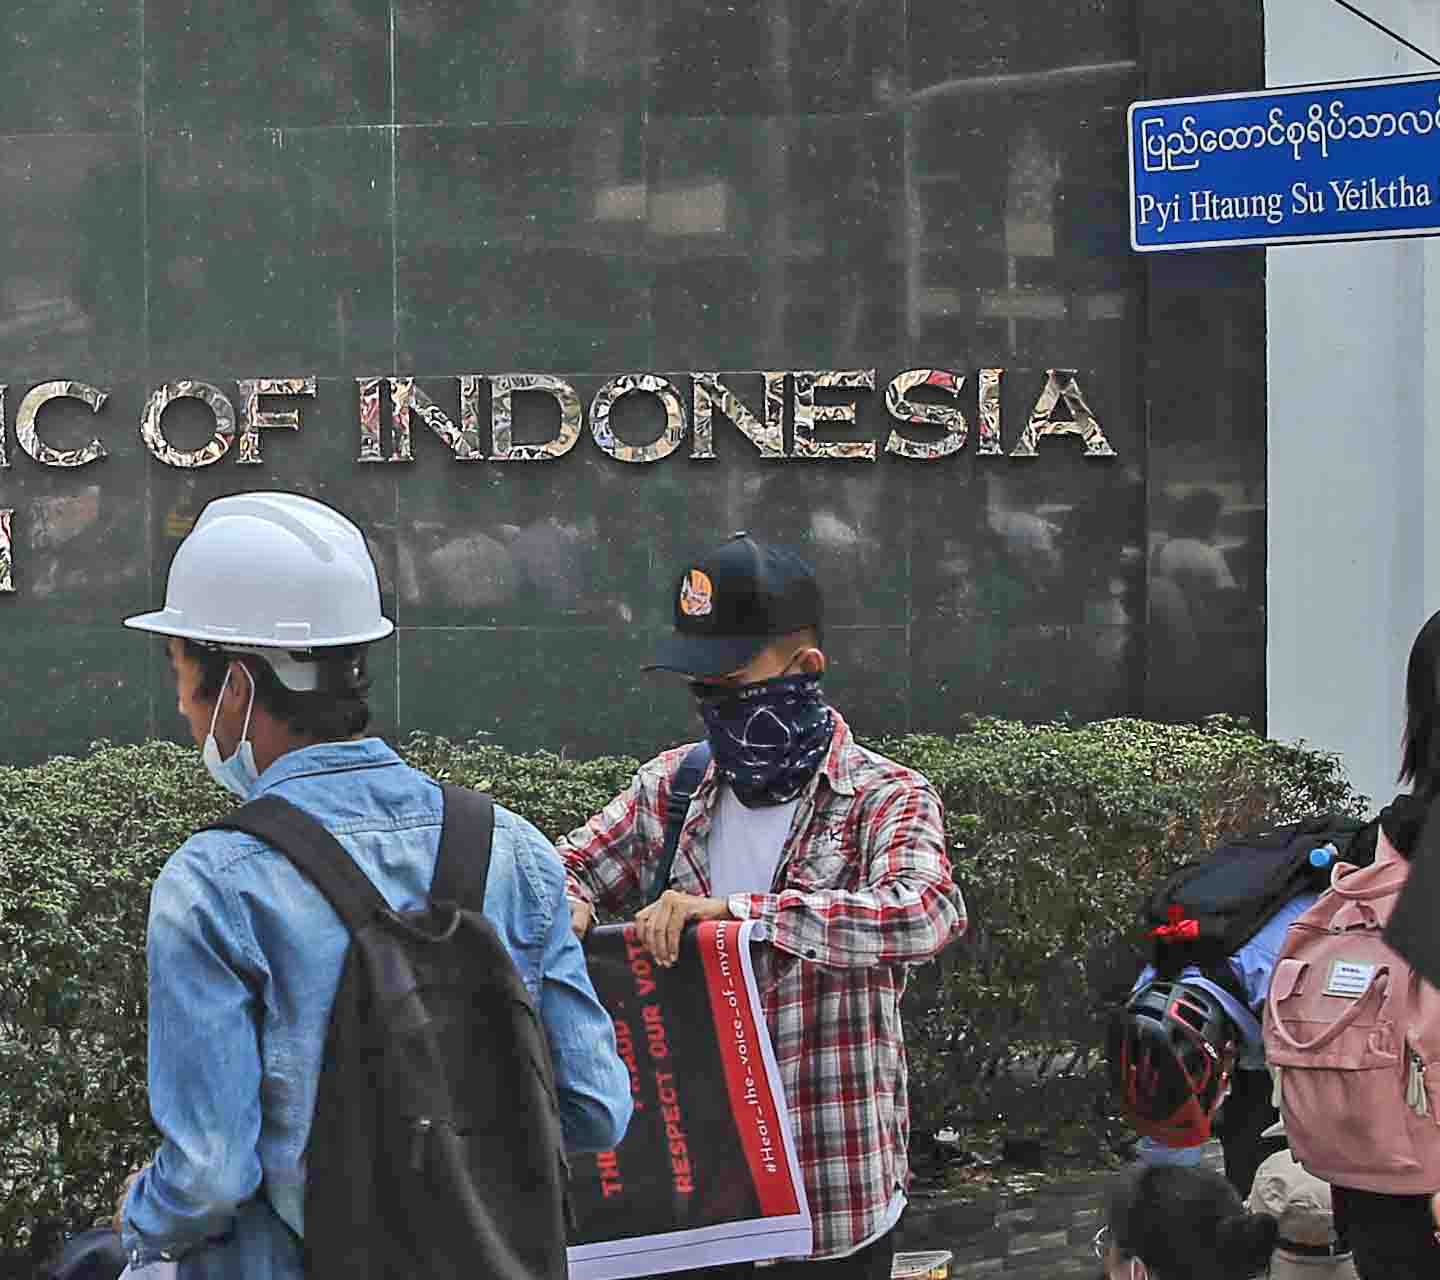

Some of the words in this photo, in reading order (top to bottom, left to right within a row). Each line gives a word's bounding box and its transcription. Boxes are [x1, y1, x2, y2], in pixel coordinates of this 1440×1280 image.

[1136, 193, 1181, 233] Pyi
[1188, 190, 1284, 225] Htaung
[1291, 181, 1326, 215] Su
[1328, 175, 1433, 212] Yeiktha
[138, 373, 318, 471] OF
[353, 364, 1118, 464] INDONESIA
[640, 1004, 670, 1059] OUR
[654, 1070, 696, 1194] RESPECT
